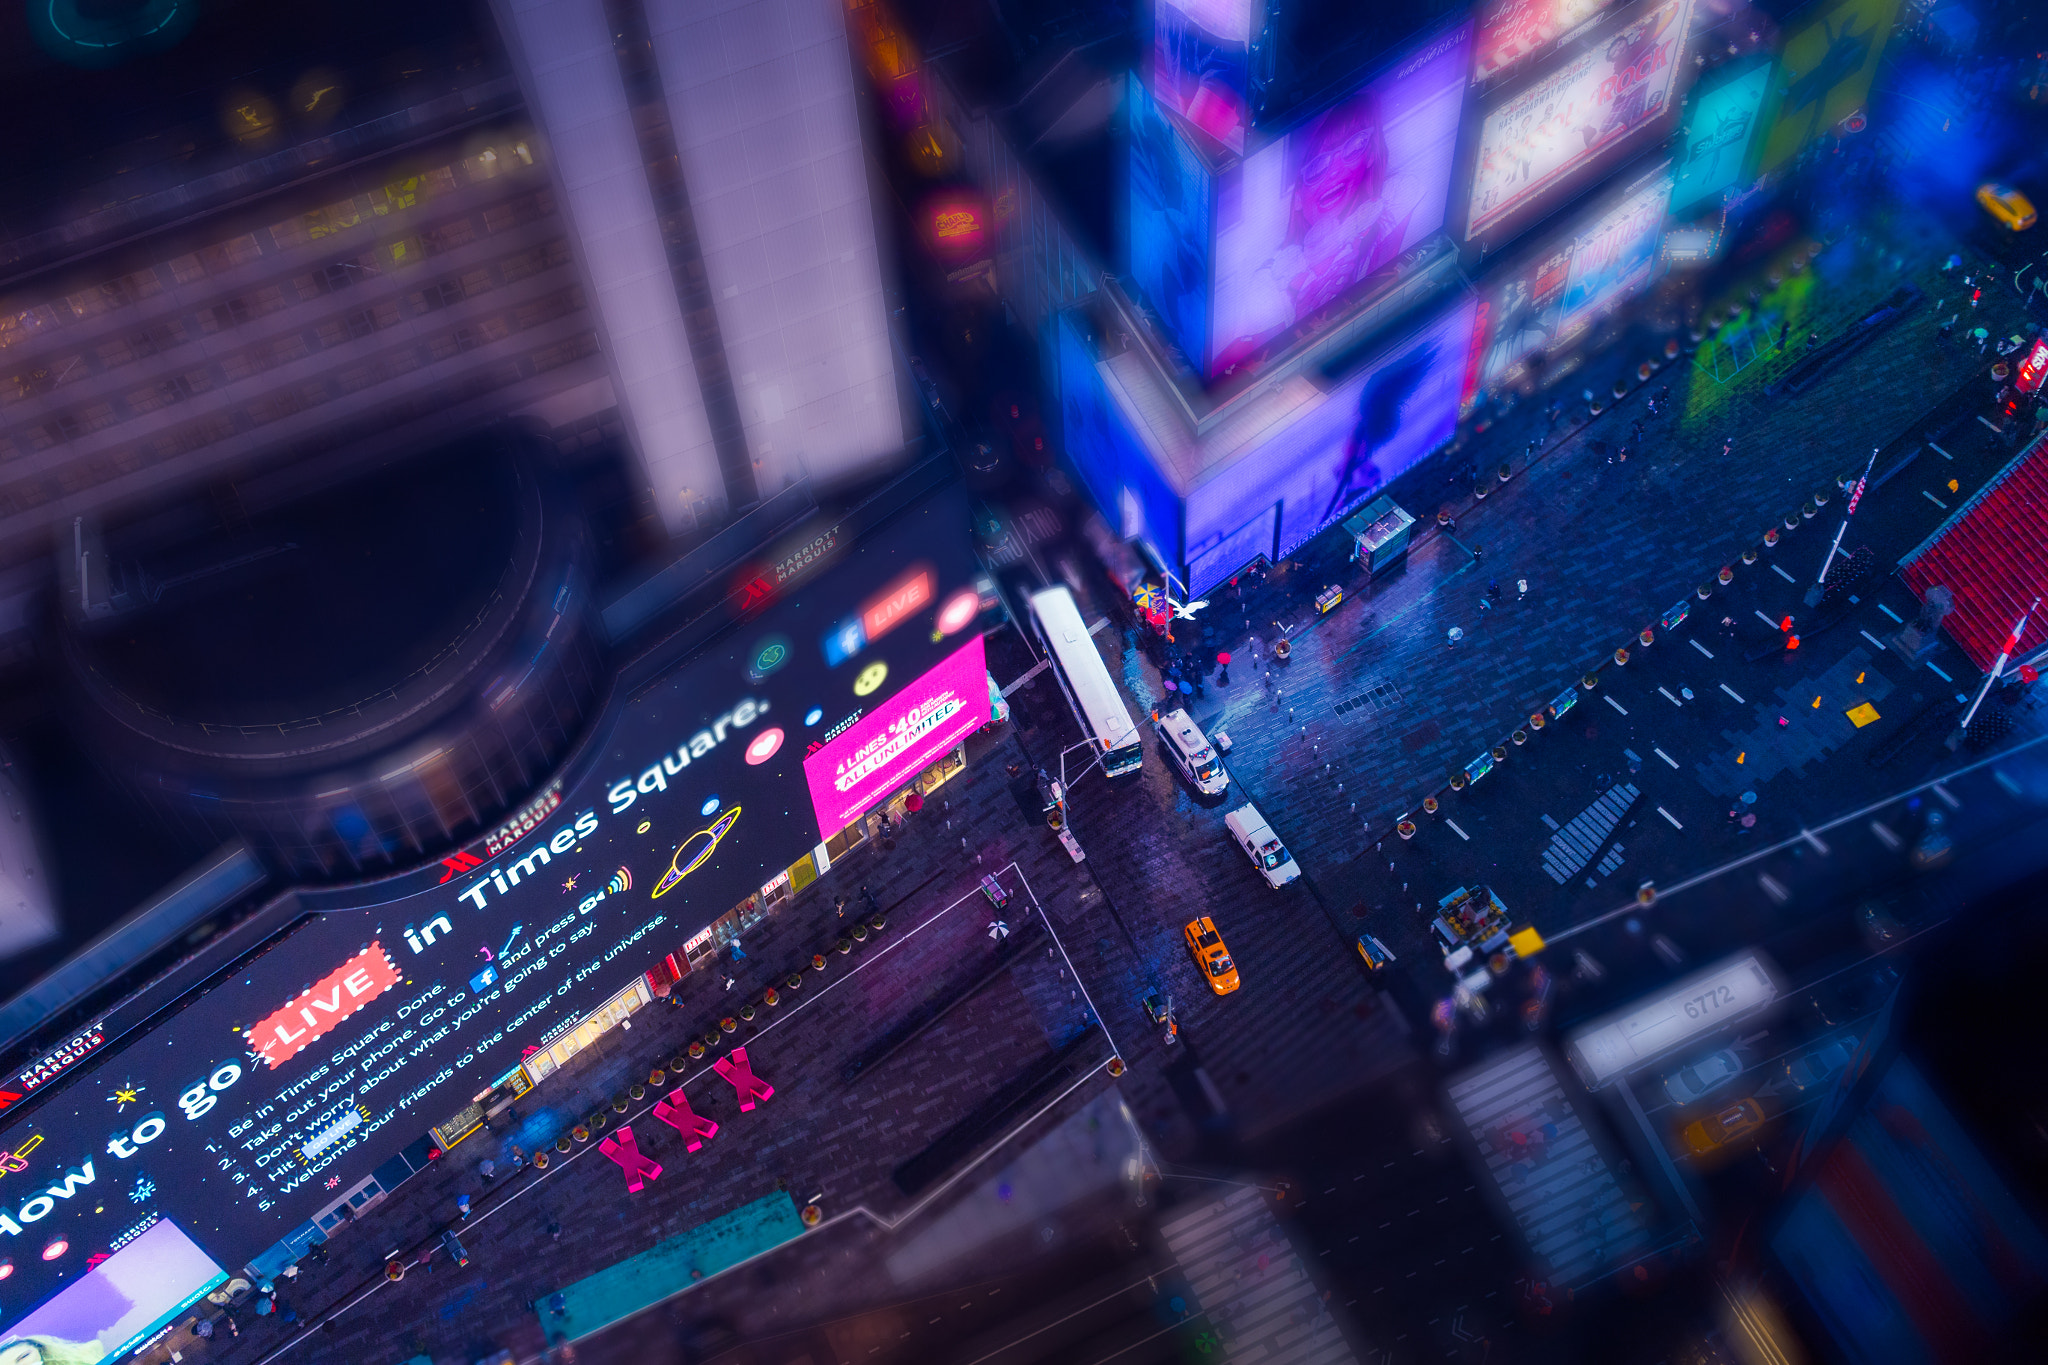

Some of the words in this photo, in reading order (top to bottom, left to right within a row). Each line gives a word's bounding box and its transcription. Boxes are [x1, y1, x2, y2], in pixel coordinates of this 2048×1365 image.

[1598, 38, 1674, 107] ROCK
[1515, 88, 1555, 122] BROADWAY
[776, 526, 839, 573] MARRIOTT
[778, 539, 834, 582] MARQUIS
[1280, 510, 1345, 559] AMERICAN
[875, 585, 920, 626] LIVE
[824, 708, 863, 738] MARRIOTT
[837, 763, 845, 775] 4
[847, 734, 887, 766] LINES
[889, 708, 921, 734] $40
[844, 765, 872, 788] ALL
[485, 781, 563, 845] MARRIOTT
[489, 794, 561, 855] MARQUIS
[106, 1118, 165, 1158] to
[179, 1065, 241, 1120] go
[275, 968, 374, 1045] LIVE
[403, 914, 453, 954] in
[458, 812, 598, 910] Times
[608, 700, 772, 815] Square.
[540, 1010, 580, 1042] MARRIOTT
[1684, 985, 1735, 1019] 6772
[20, 1022, 103, 1082] MARRIOTT
[26, 1035, 103, 1089] MARQUIS
[218, 1158, 236, 1170] 2.
[241, 1123, 282, 1153] Take
[286, 1097, 316, 1122] out
[319, 1068, 356, 1103] your
[361, 1030, 417, 1072] phone.
[420, 1008, 444, 1027] Go
[448, 992, 465, 1007] to
[501, 943, 531, 969] and
[535, 913, 575, 948] press
[232, 1173, 250, 1184] 3.
[306, 1093, 354, 1132] worry
[359, 1056, 407, 1094] about
[410, 1025, 450, 1057] what
[504, 956, 548, 993] going
[549, 943, 566, 958] to
[569, 921, 597, 944] say.
[258, 1200, 276, 1212] 5.
[280, 1139, 357, 1194] Welcome
[360, 1108, 395, 1141] your
[399, 1067, 454, 1109] friends
[456, 1054, 473, 1069] to
[477, 1032, 502, 1053] the
[506, 995, 553, 1032] center
[557, 979, 573, 995] of
[576, 960, 601, 982] the
[604, 916, 667, 962] universe.
[205, 1143, 222, 1154] 1.
[228, 1119, 253, 1138] Be
[256, 1104, 274, 1119] in
[275, 1065, 329, 1102] Times
[332, 1021, 395, 1065] Square.
[397, 985, 446, 1019] Done.
[246, 1186, 263, 1198] 4.
[268, 1160, 296, 1182] Hit
[312, 1136, 328, 1149] GO
[329, 1120, 352, 1138] LIVE
[110, 1211, 158, 1248] MARRIOTT
[114, 1219, 157, 1251] MARQUIS
